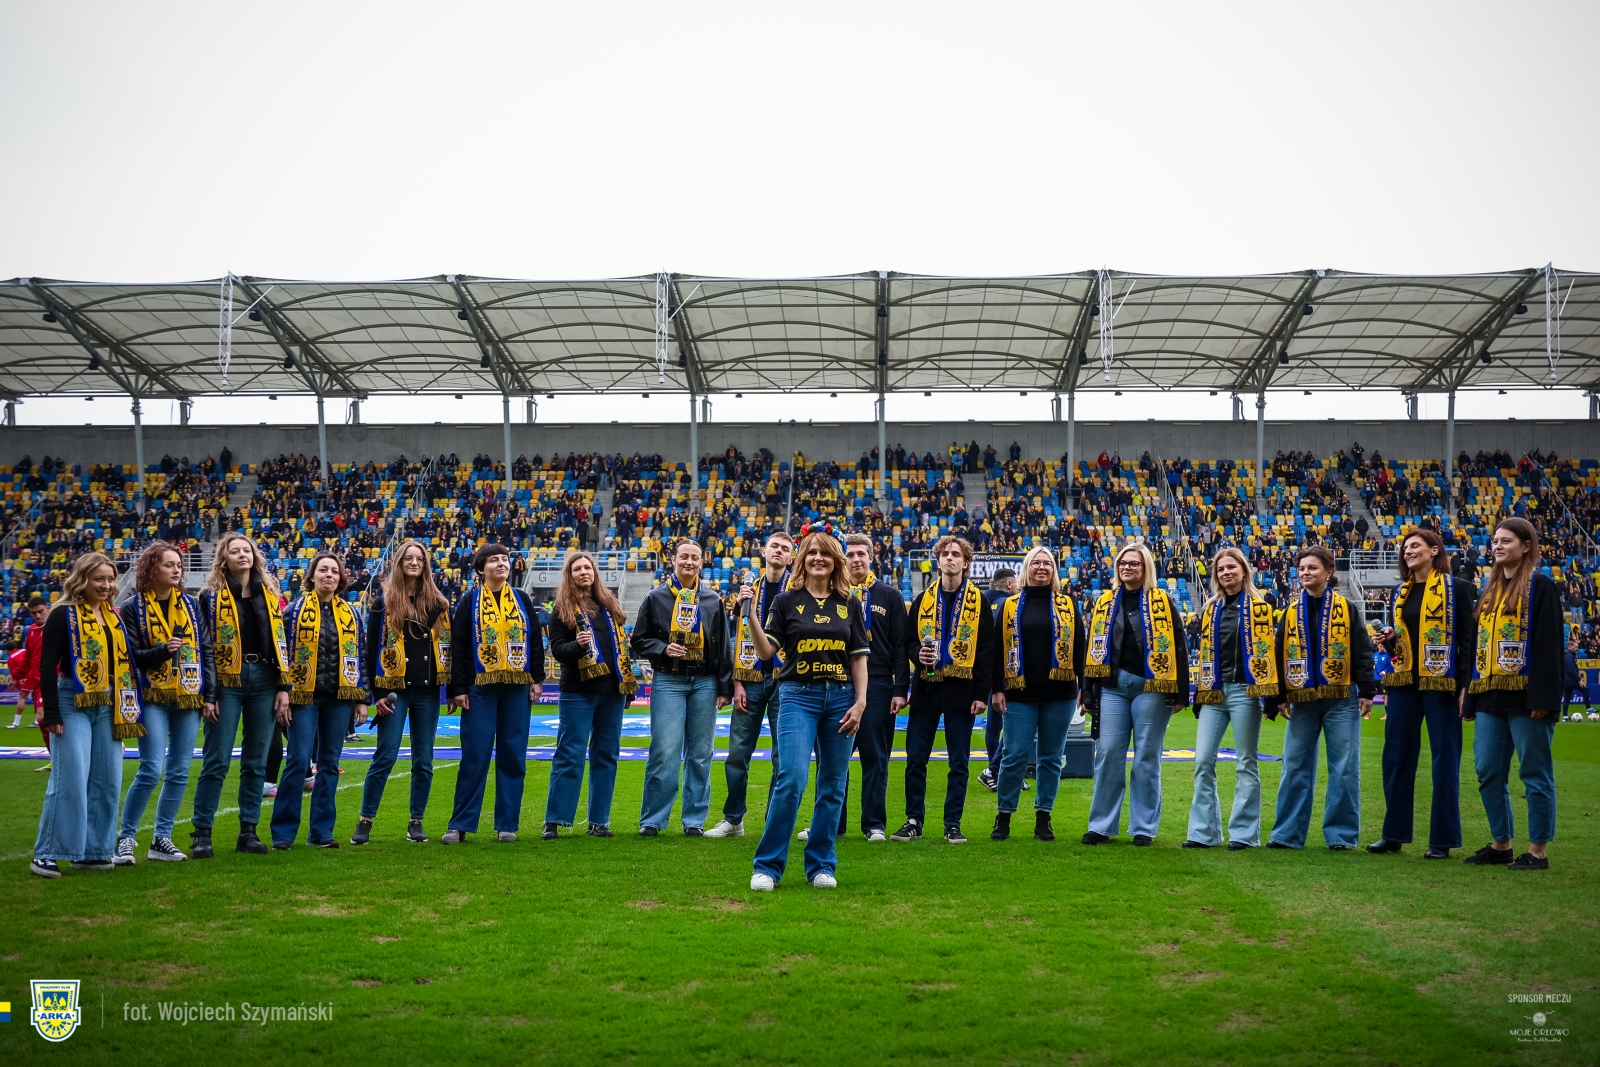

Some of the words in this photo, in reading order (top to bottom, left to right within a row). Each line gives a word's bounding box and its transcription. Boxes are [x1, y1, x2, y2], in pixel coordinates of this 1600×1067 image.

[539, 572, 547, 582] G
[605, 572, 617, 582] 15
[1360, 571, 1367, 580] H
[812, 662, 844, 674] Energ
